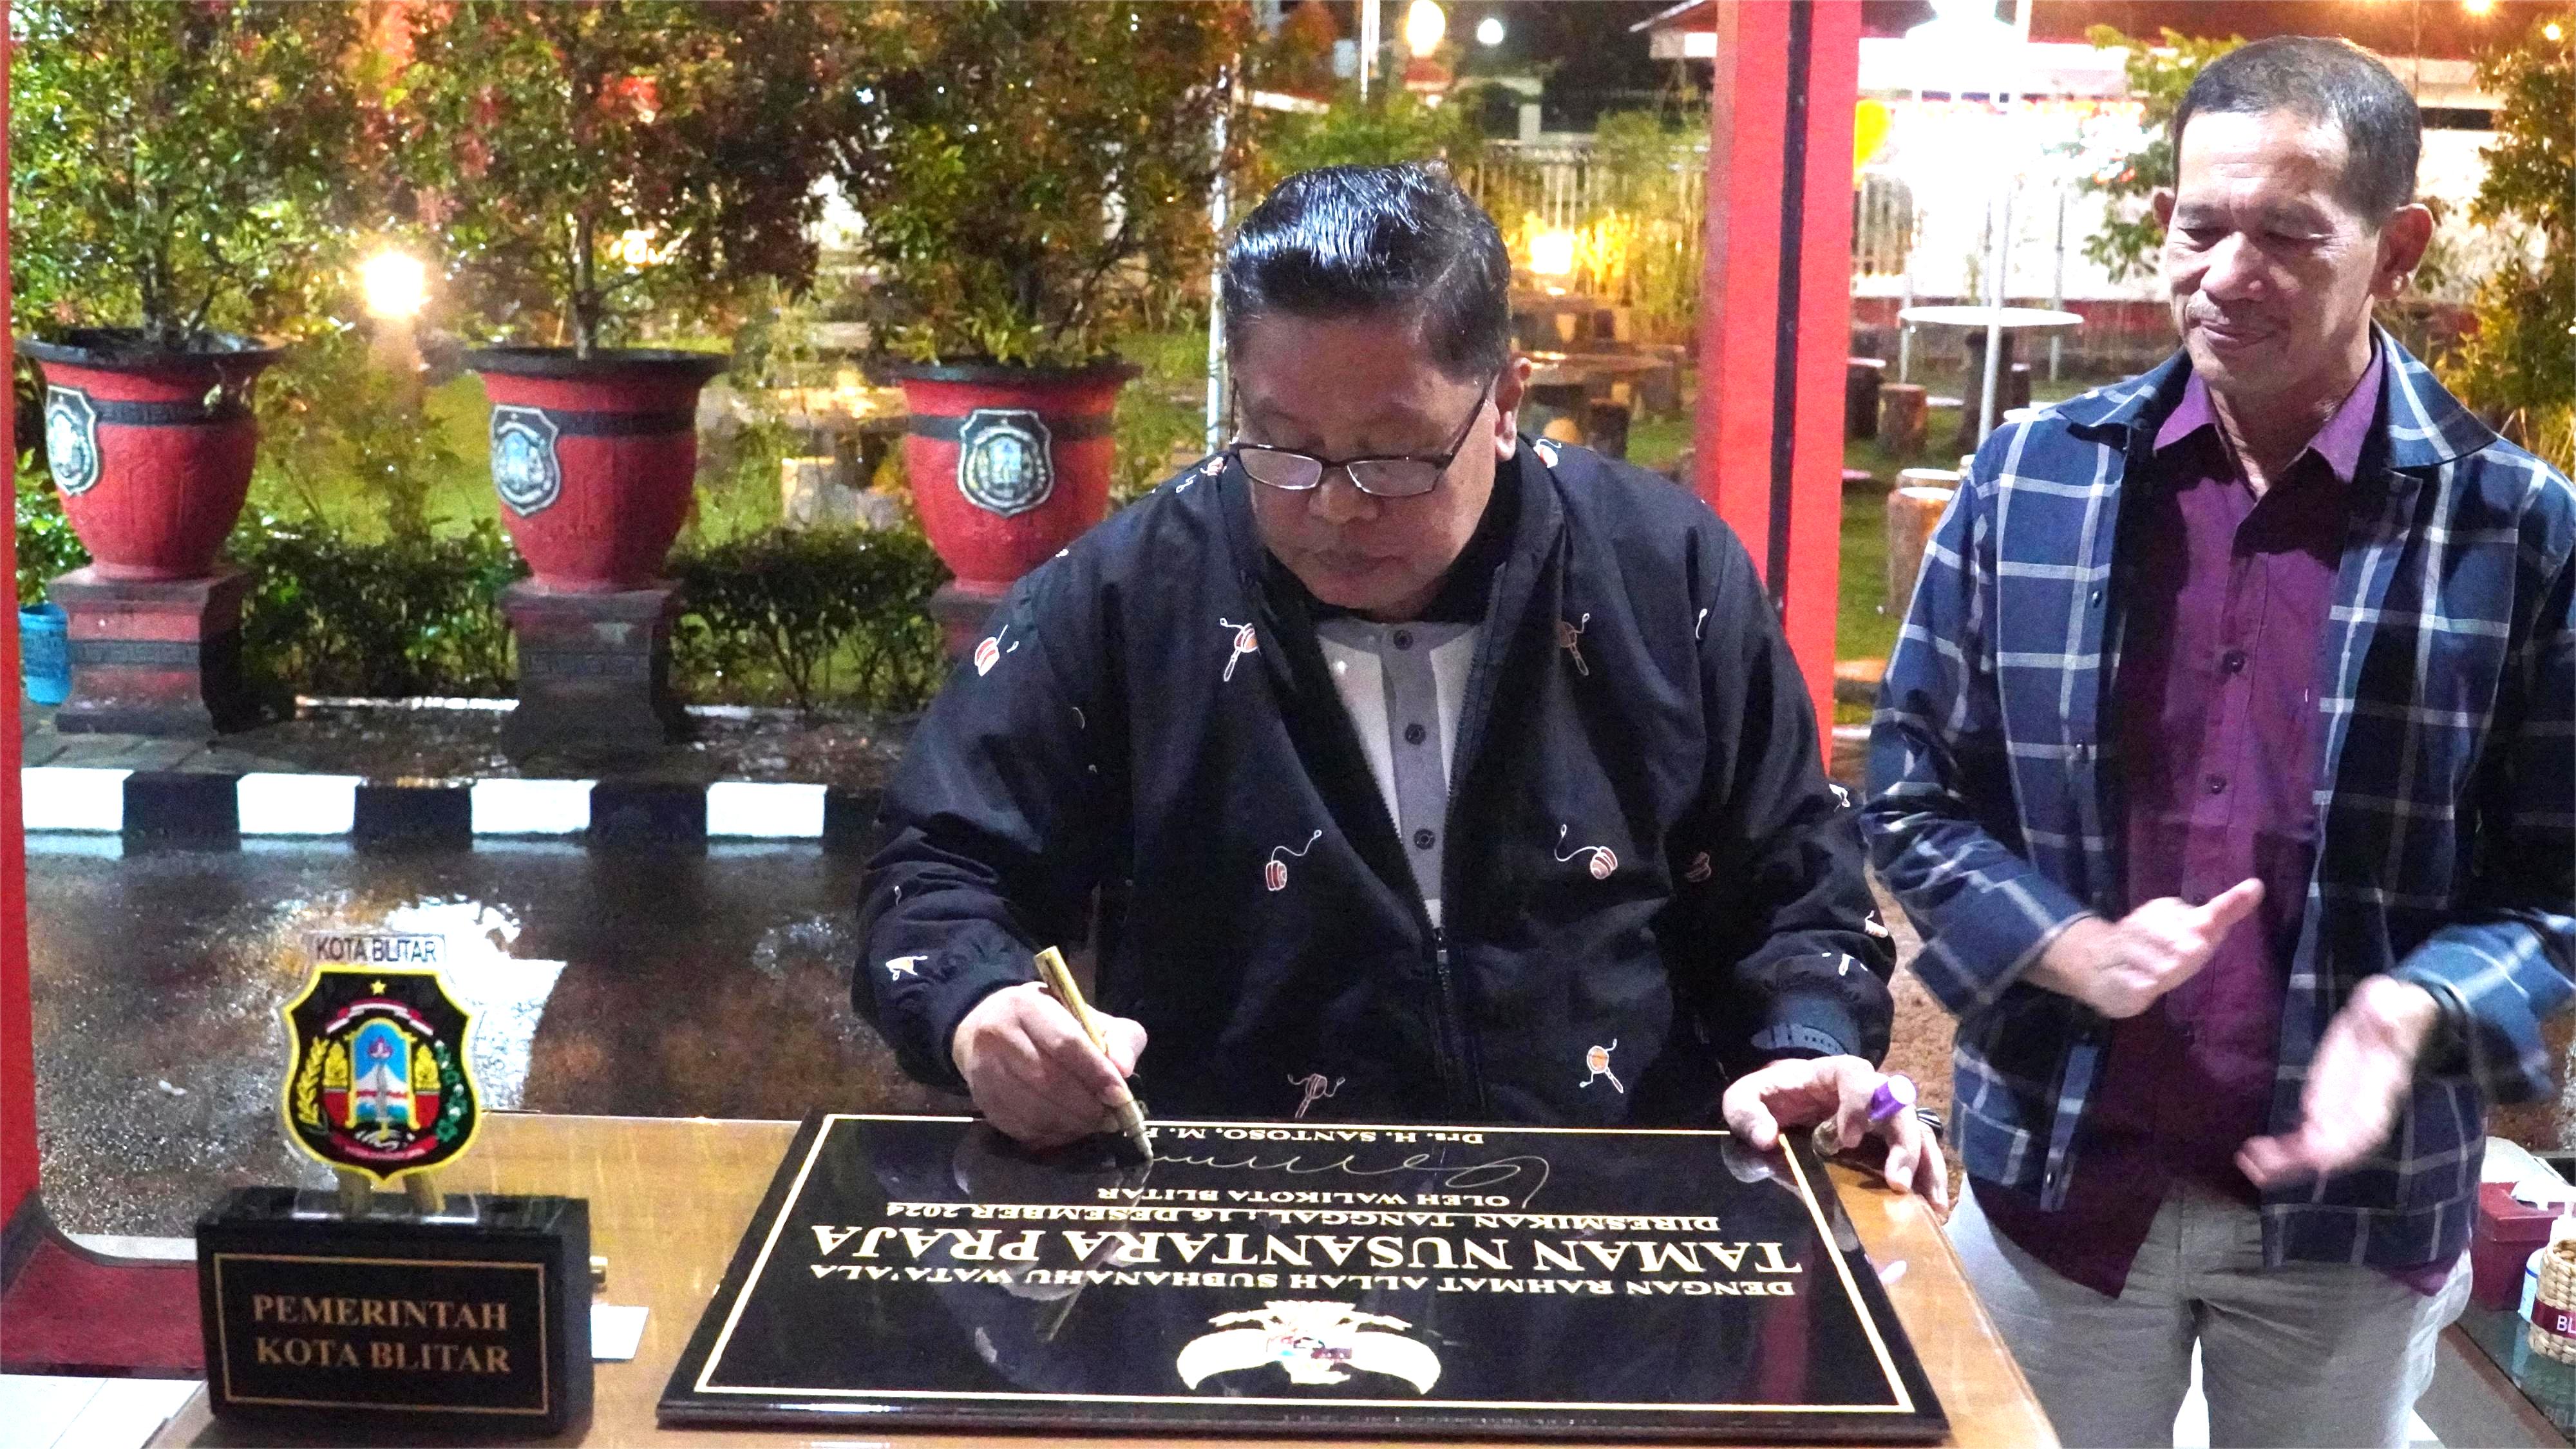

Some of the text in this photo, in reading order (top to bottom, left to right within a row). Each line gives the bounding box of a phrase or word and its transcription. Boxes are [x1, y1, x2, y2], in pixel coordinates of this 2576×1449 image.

[316, 937, 437, 963] KOTA BLITAR
[1169, 1128, 1206, 1139] M.
[1215, 1128, 1376, 1142] SANTOSO,
[1385, 1132, 1417, 1142] H.
[1426, 1133, 1484, 1144] Drs.
[1097, 1187, 1510, 1206] OLEH WALIKOTA BLITAR
[886, 1204, 960, 1218] 2024
[969, 1206, 1178, 1222] DESEMBER
[1189, 1209, 1232, 1222] 16
[1268, 1211, 1455, 1227] TANGGAL
[1475, 1215, 1719, 1231] DIRESMIKAN
[811, 1226, 1803, 1273] TAMAN NUSANTARA PRAJA
[810, 1264, 1795, 1296] DENGAN RAHMAT ALLAH SUBHANAHU WATA'ALA
[252, 1294, 508, 1331] PEMERINTAH
[257, 1336, 511, 1374] KOTA BLITAR
